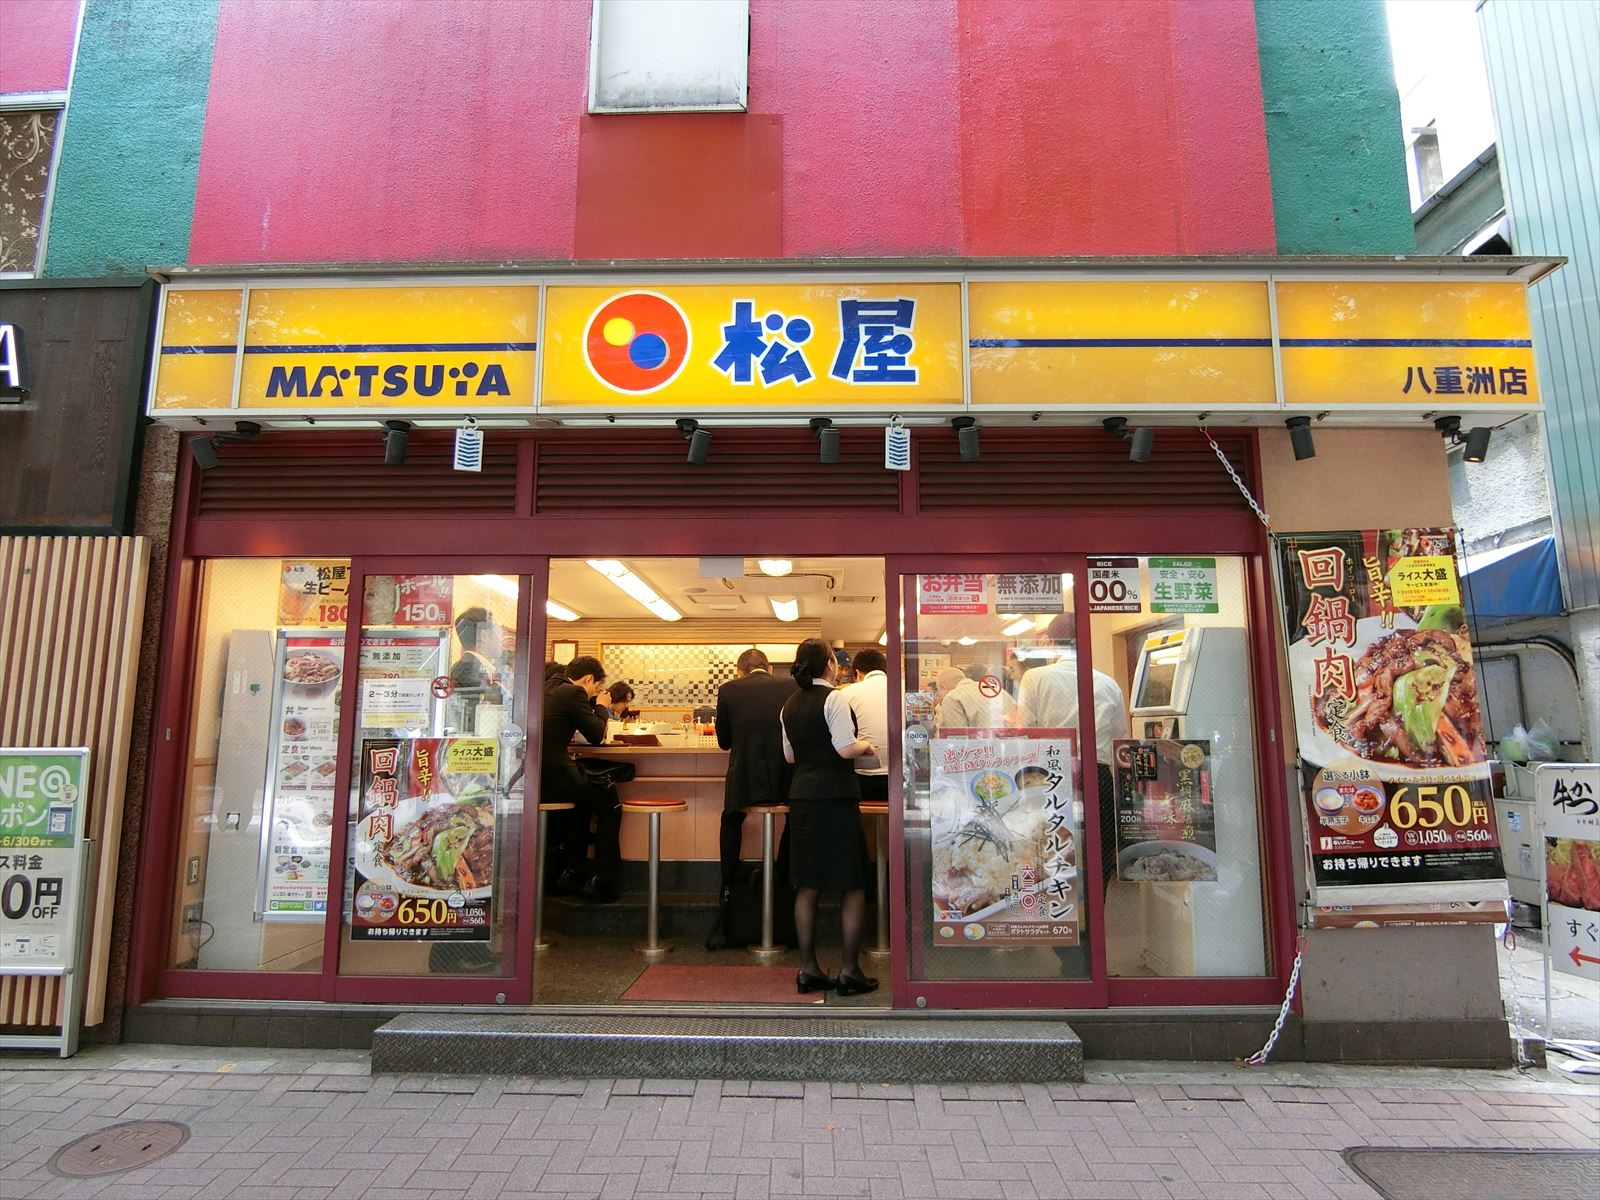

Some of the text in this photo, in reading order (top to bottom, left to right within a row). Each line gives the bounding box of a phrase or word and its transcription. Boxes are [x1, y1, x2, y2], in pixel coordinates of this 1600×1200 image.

[713, 299, 917, 385] 松屋
[265, 361, 511, 398] MATSUYA
[1402, 366, 1527, 395] 八重洲店
[1092, 569, 1120, 579] 国産米
[1159, 570, 1206, 580] 安全・安心
[1397, 568, 1448, 581] ライス大盛
[922, 574, 983, 593] お弁当
[997, 575, 1062, 595] 無添加
[1154, 582, 1213, 601] 生野菜
[1298, 546, 1356, 744] 回鍋肉 定食
[906, 732, 928, 740] TOUCH
[452, 746, 495, 757] ライス大盛
[1321, 854, 1422, 871] お持ち帰りできます
[32, 906, 59, 919] OFF
